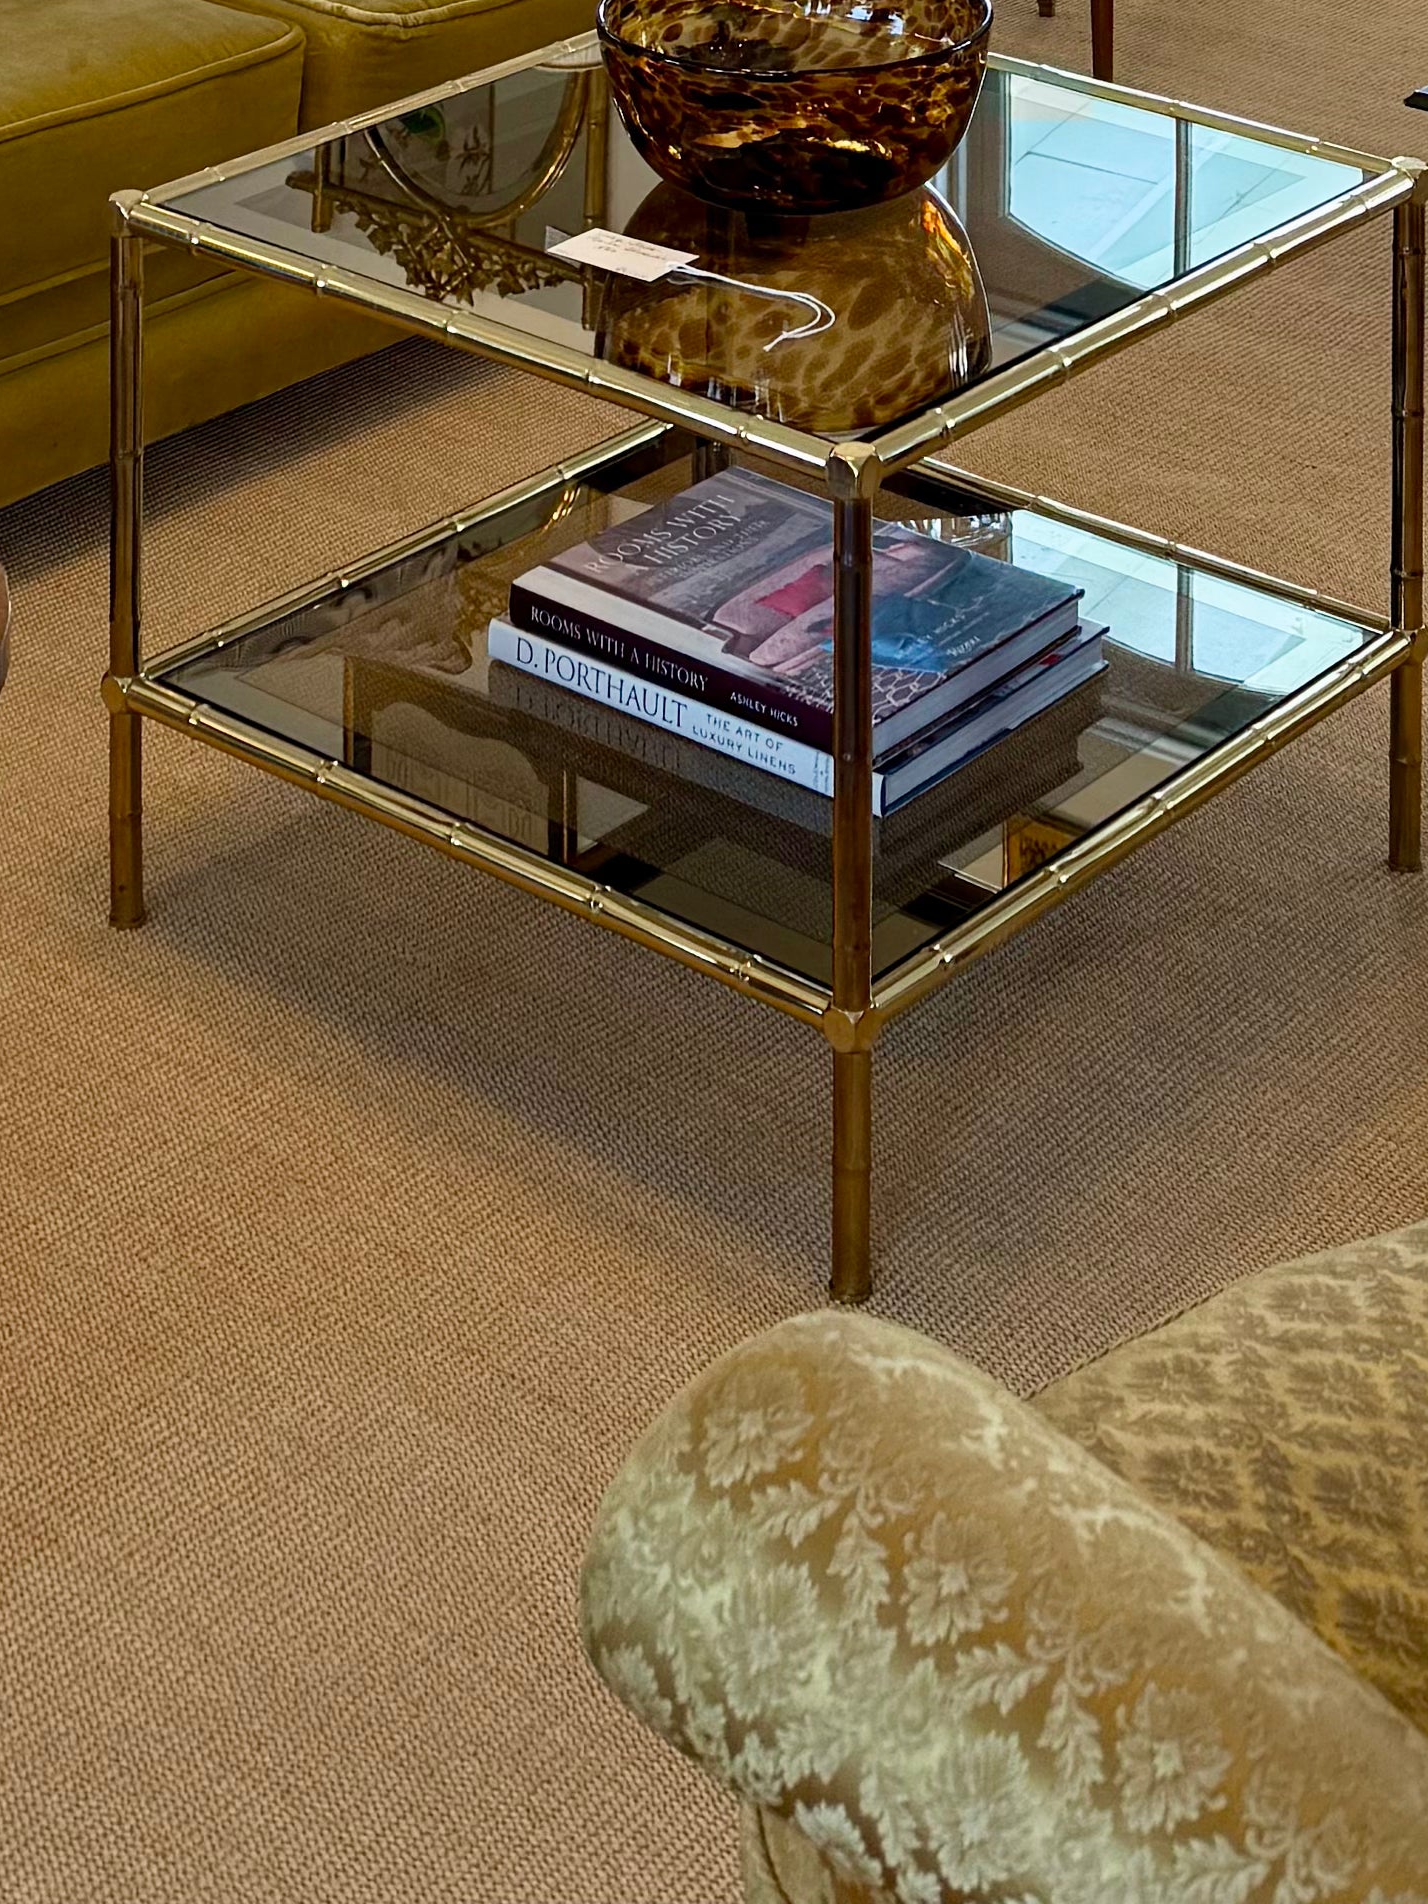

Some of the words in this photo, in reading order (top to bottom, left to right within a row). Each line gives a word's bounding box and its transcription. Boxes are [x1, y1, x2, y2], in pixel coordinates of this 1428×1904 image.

[583, 527, 673, 574] ROOMS
[666, 494, 736, 528] WITH
[643, 512, 742, 565] HISTORY
[530, 605, 582, 641] ROOMS
[585, 628, 625, 660] WITH
[630, 647, 640, 666] A
[645, 653, 709, 692] HISTORY
[516, 637, 539, 670] D.
[544, 648, 688, 729] PORTHAULT
[730, 691, 767, 715] ASHLEY
[769, 707, 799, 728] HICKS
[692, 726, 743, 752] LUXURY
[747, 743, 797, 776] LINENS
[705, 712, 731, 733] THE
[735, 725, 761, 744] ART
[765, 734, 784, 752] OF
